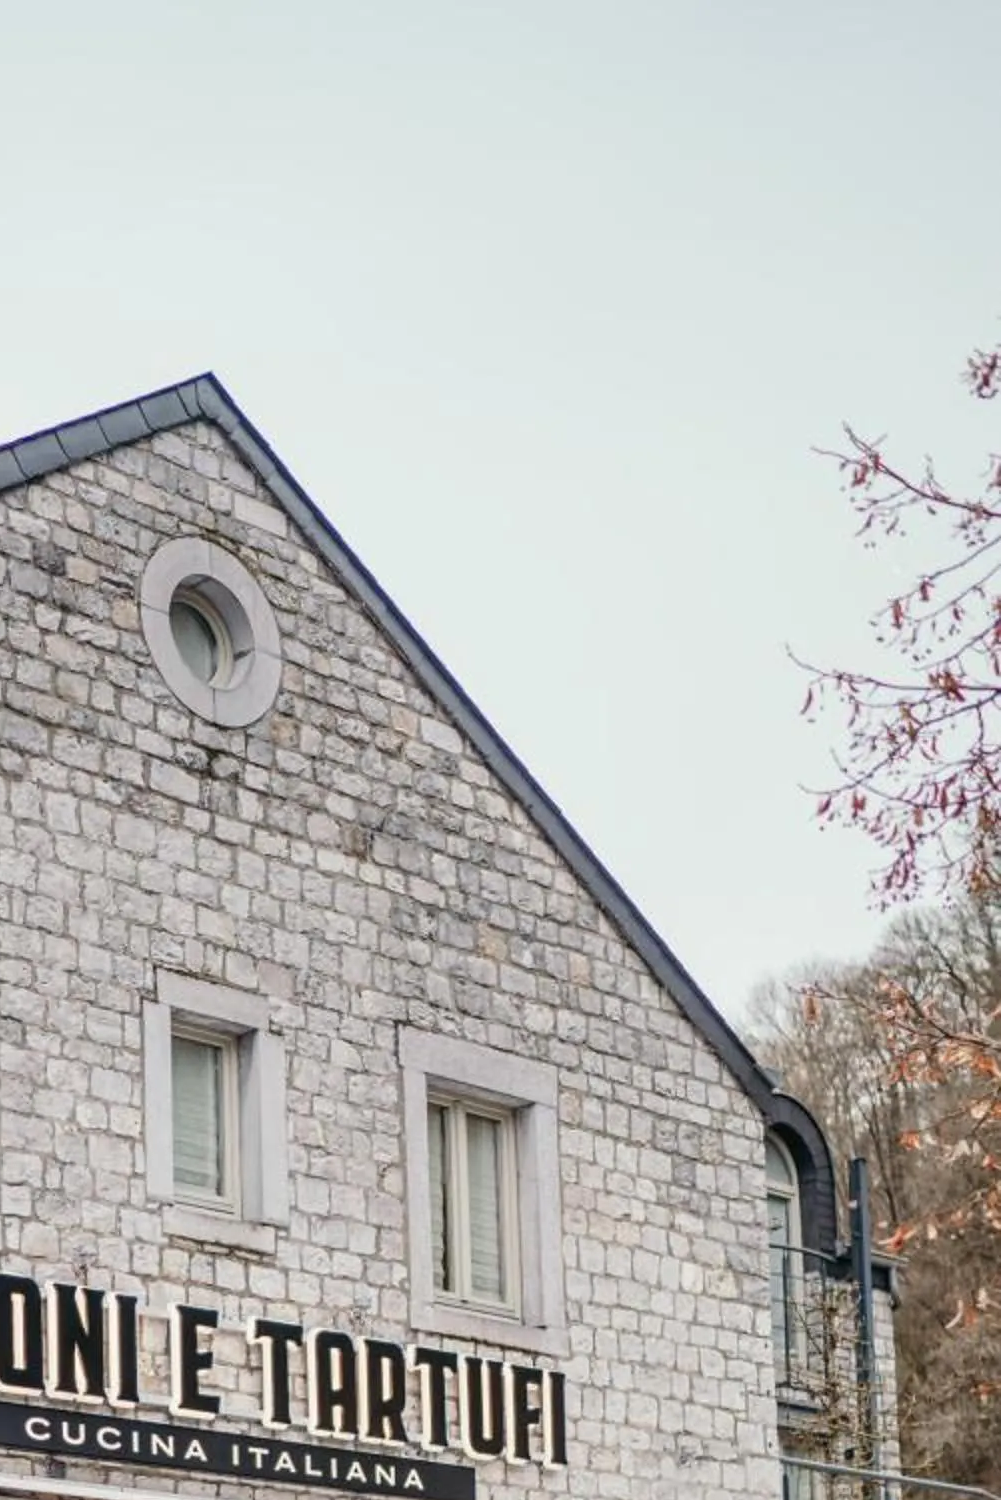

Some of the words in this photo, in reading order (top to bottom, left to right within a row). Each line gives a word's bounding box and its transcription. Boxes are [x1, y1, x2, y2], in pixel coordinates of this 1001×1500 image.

[169, 1302, 219, 1419] E
[248, 1316, 567, 1469] TARTUFI
[24, 1416, 208, 1462] CUCINA
[231, 1446, 426, 1492] ITALIANA
